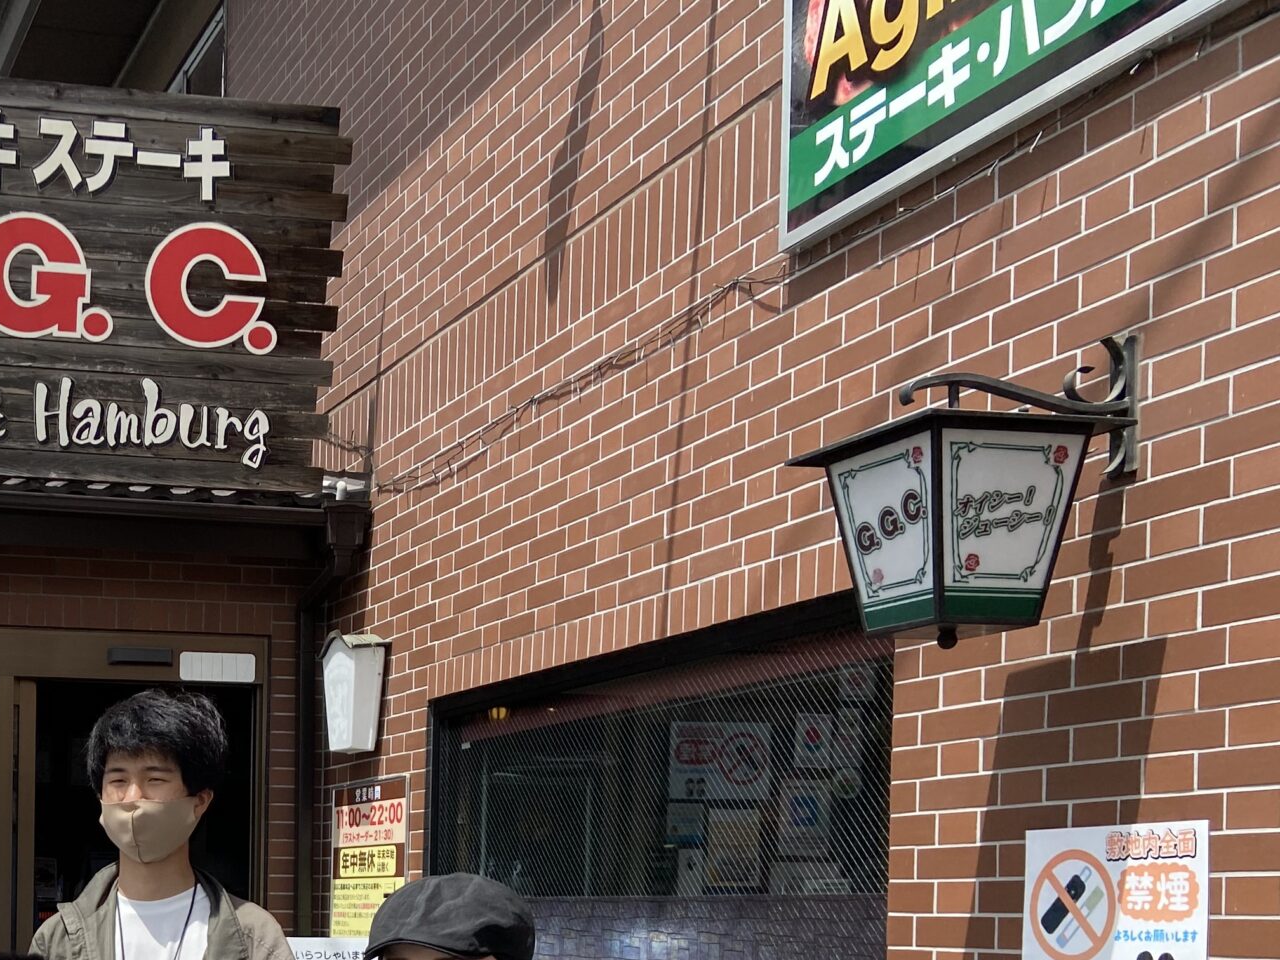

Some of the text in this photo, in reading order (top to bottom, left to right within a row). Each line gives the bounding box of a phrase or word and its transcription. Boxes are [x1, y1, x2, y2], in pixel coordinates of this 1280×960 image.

[809, 0, 953, 100] Ag
[814, 0, 1108, 187] ステーキ・ハン
[32, 116, 231, 201] ステーキ
[35, 376, 271, 468] Hamburg
[341, 849, 376, 873] 年中無休
[1105, 828, 1197, 862] 敷地内全面
[1124, 871, 1192, 913] 禁煙
[1113, 929, 1199, 944] よろしくお願いします
